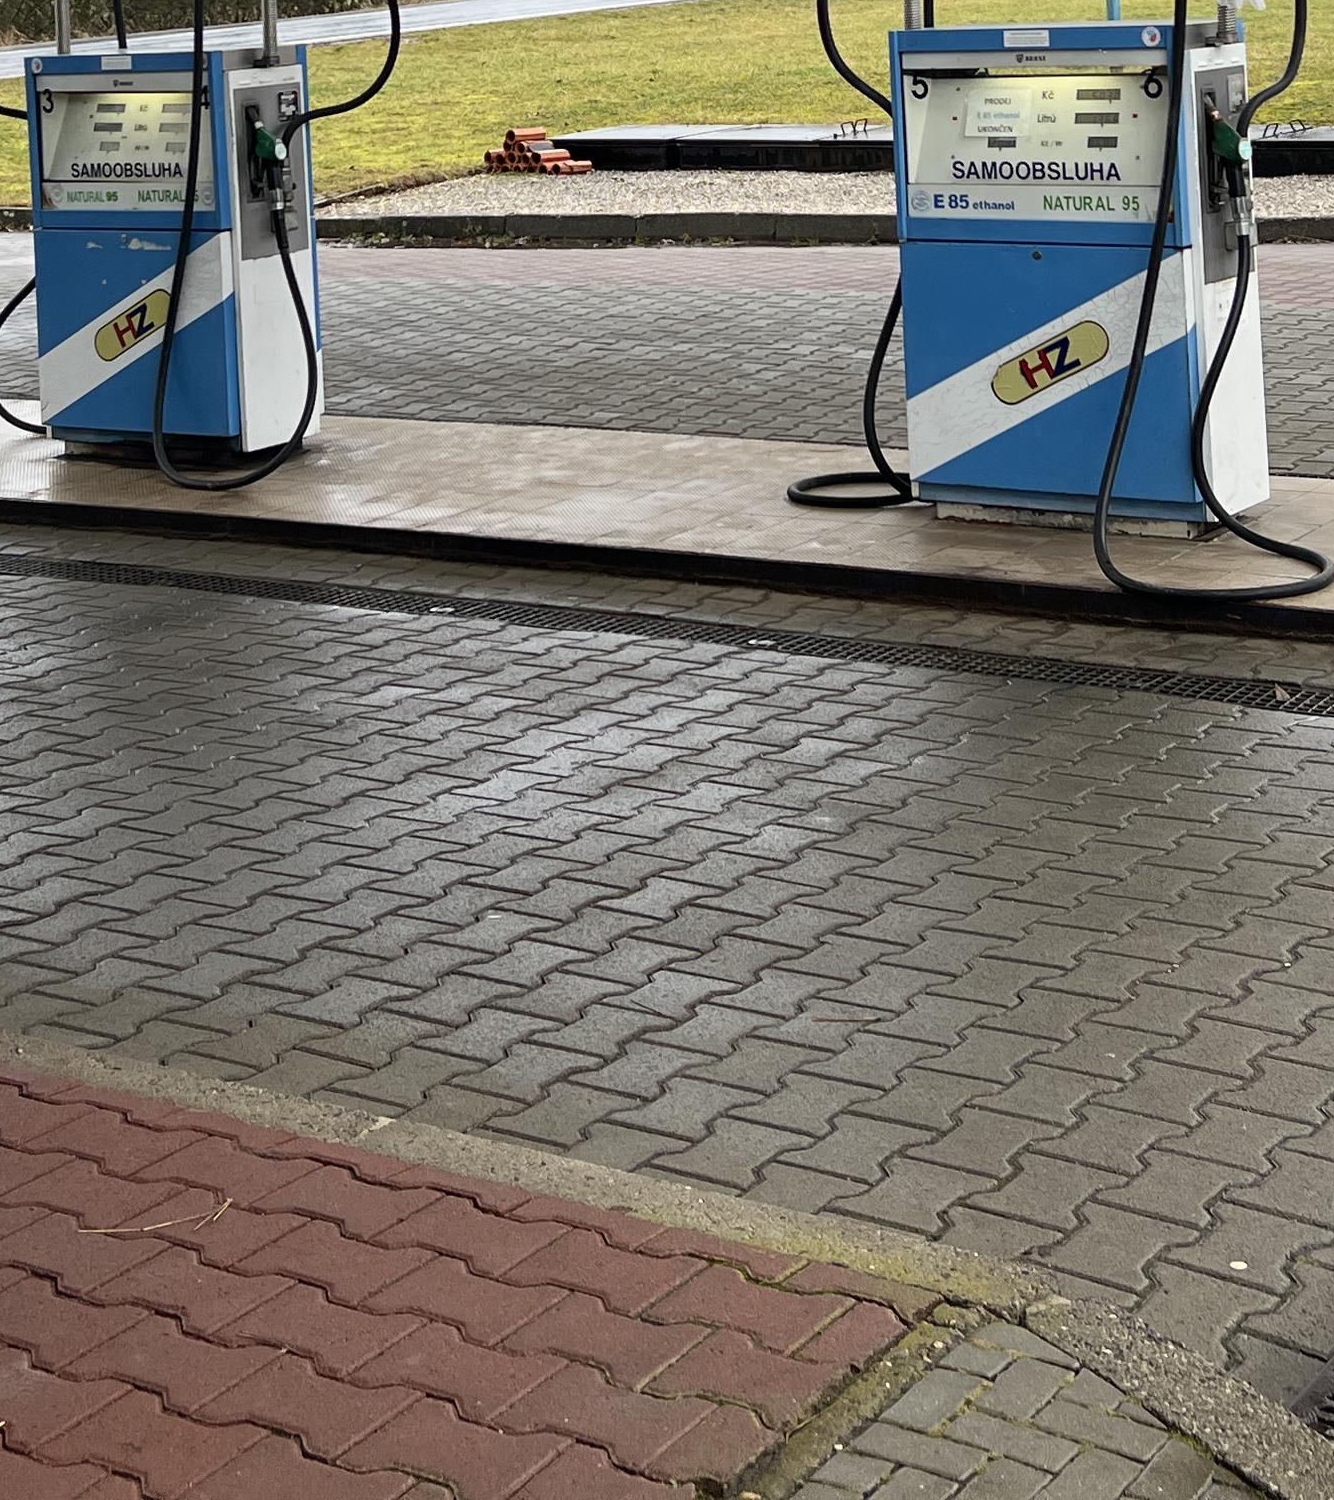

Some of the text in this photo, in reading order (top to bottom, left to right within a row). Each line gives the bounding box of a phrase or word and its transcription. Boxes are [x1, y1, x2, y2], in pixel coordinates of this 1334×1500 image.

[910, 74, 930, 100] 5
[1142, 67, 1163, 99] 6
[41, 88, 55, 114] 3
[70, 162, 184, 179] SAMOOBSLUHA
[951, 160, 1122, 182] SAMOOBSLUHA
[67, 190, 119, 203] NATURAL 95
[138, 189, 186, 203] NATURAL
[933, 194, 1015, 211] E 85 ethanol
[1043, 195, 1141, 212] NATURAL 95
[112, 302, 156, 349] HZ
[1018, 335, 1082, 390] HZ
